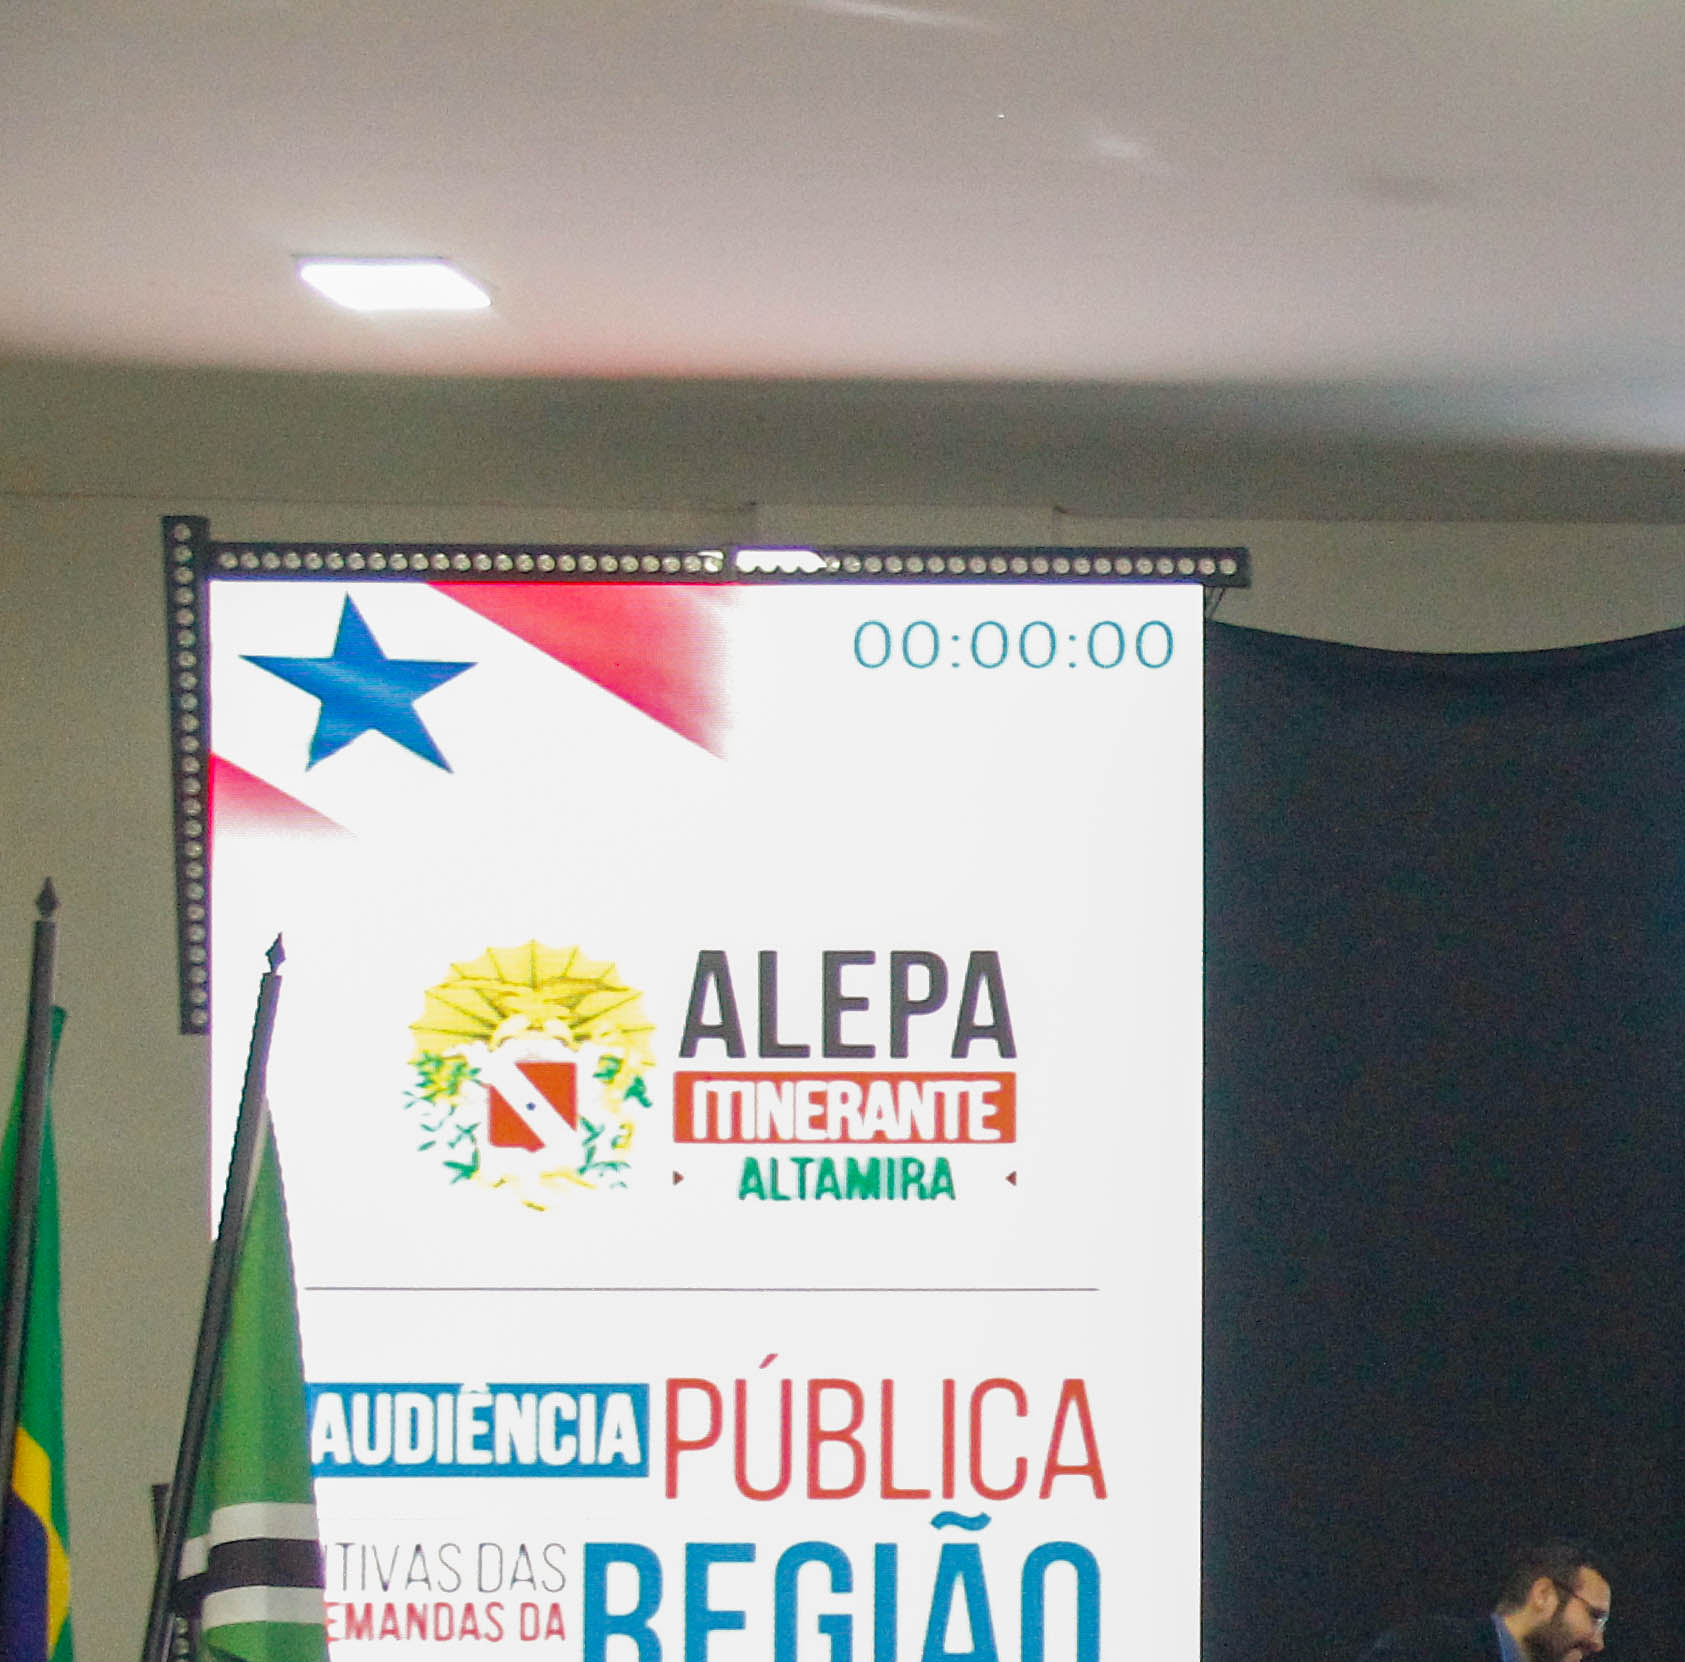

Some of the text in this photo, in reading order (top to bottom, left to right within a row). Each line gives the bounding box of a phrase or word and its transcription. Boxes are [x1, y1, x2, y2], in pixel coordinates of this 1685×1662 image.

[854, 620, 1173, 669] 00:00:00
[679, 950, 1017, 1059] ALEPA
[693, 1079, 1001, 1141] ITINERANTE
[738, 1156, 956, 1201] ALTAMIRA
[311, 1353, 1108, 1501] AUDIÊNCIA PÚBLICA
[478, 1543, 566, 1592] DAS
[324, 1602, 566, 1642] EMANDAS DA
